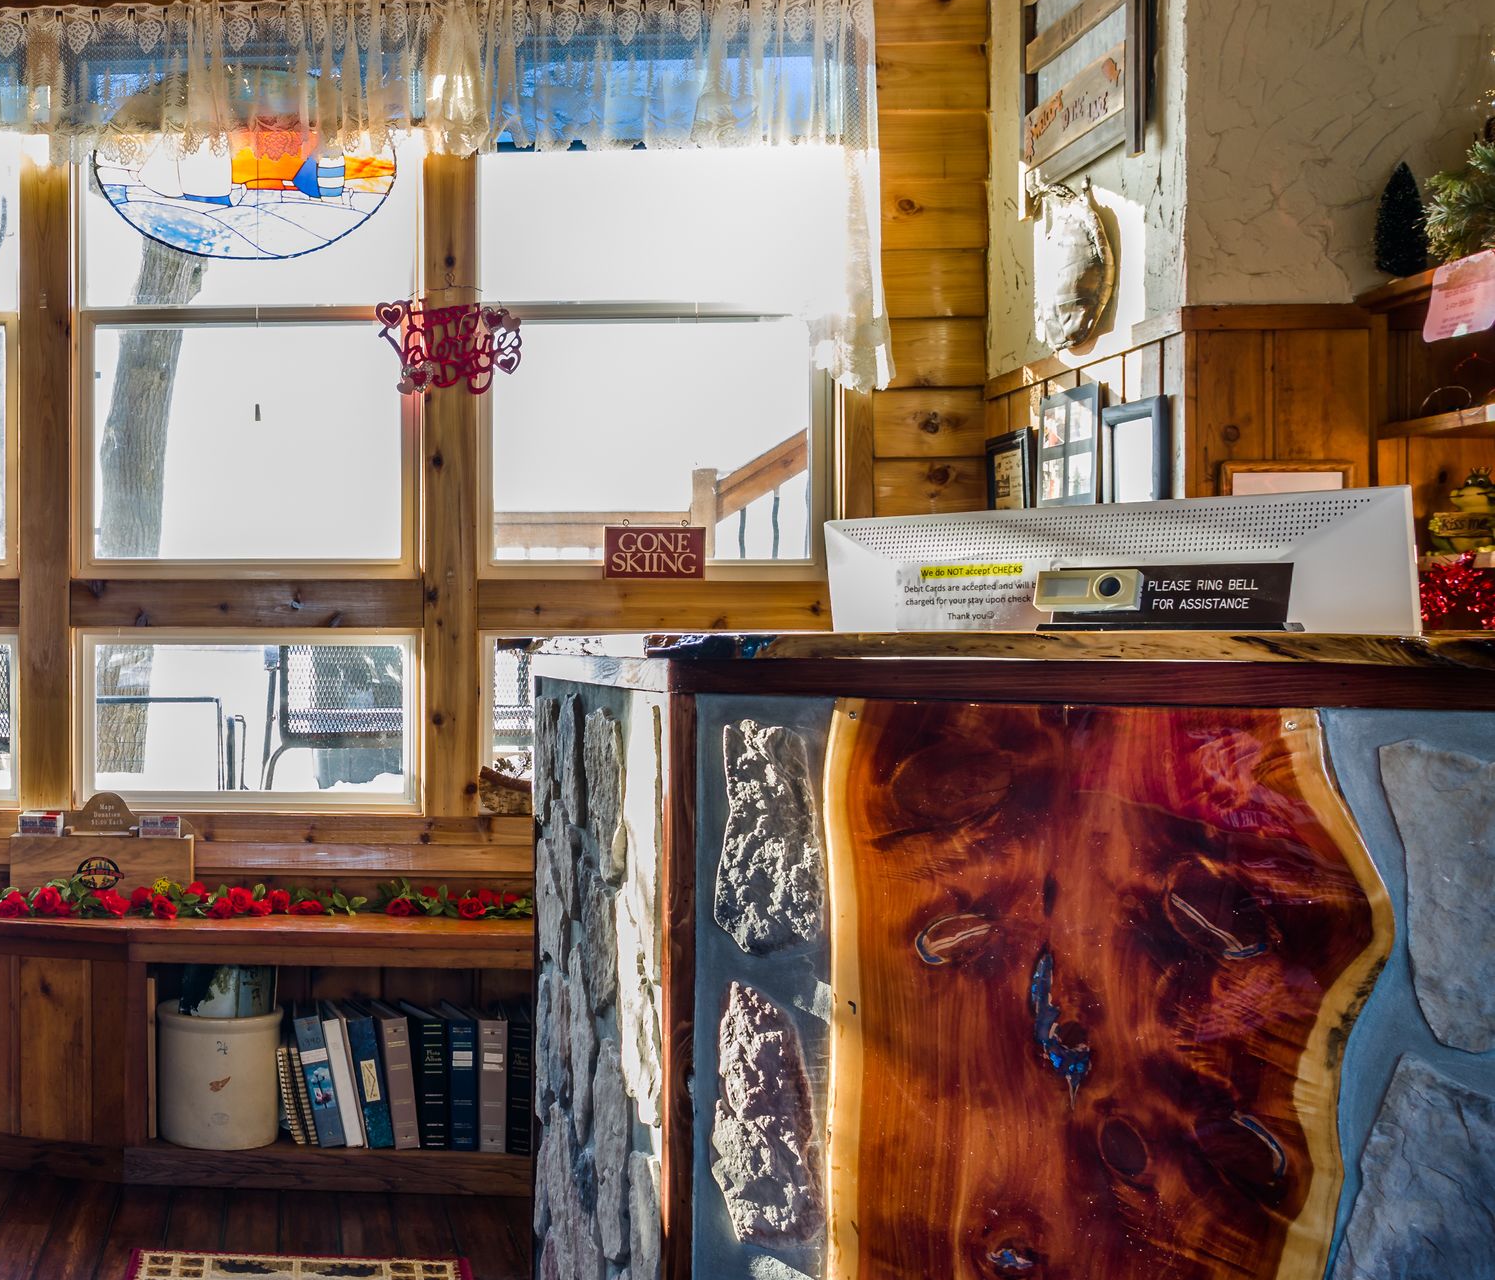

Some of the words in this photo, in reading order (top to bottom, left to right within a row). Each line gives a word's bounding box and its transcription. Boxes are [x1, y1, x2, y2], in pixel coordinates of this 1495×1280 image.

[1061, 2, 1084, 41] BAIT
[618, 532, 691, 553] GONE
[611, 552, 697, 574] SKIING
[920, 569, 933, 577] We
[935, 568, 945, 576] do
[947, 567, 963, 575] NOT
[965, 567, 991, 576] accept
[992, 565, 1023, 574] CHECKS
[904, 585, 924, 593] Debit
[925, 584, 946, 592] Cards
[962, 582, 997, 592] accepted
[1015, 581, 1030, 589] will
[1147, 580, 1191, 592] PLEASE
[1196, 579, 1223, 591] RING
[1228, 578, 1259, 591] BELL
[905, 597, 935, 607] charged
[936, 596, 947, 605] for
[949, 597, 966, 606] your
[967, 596, 984, 605] stay
[985, 596, 1006, 605] upon
[1007, 594, 1032, 603] check
[1152, 598, 1174, 610] FOR
[1178, 597, 1250, 610] ASSISTANCE
[947, 612, 971, 620] Thank
[972, 613, 987, 621] you
